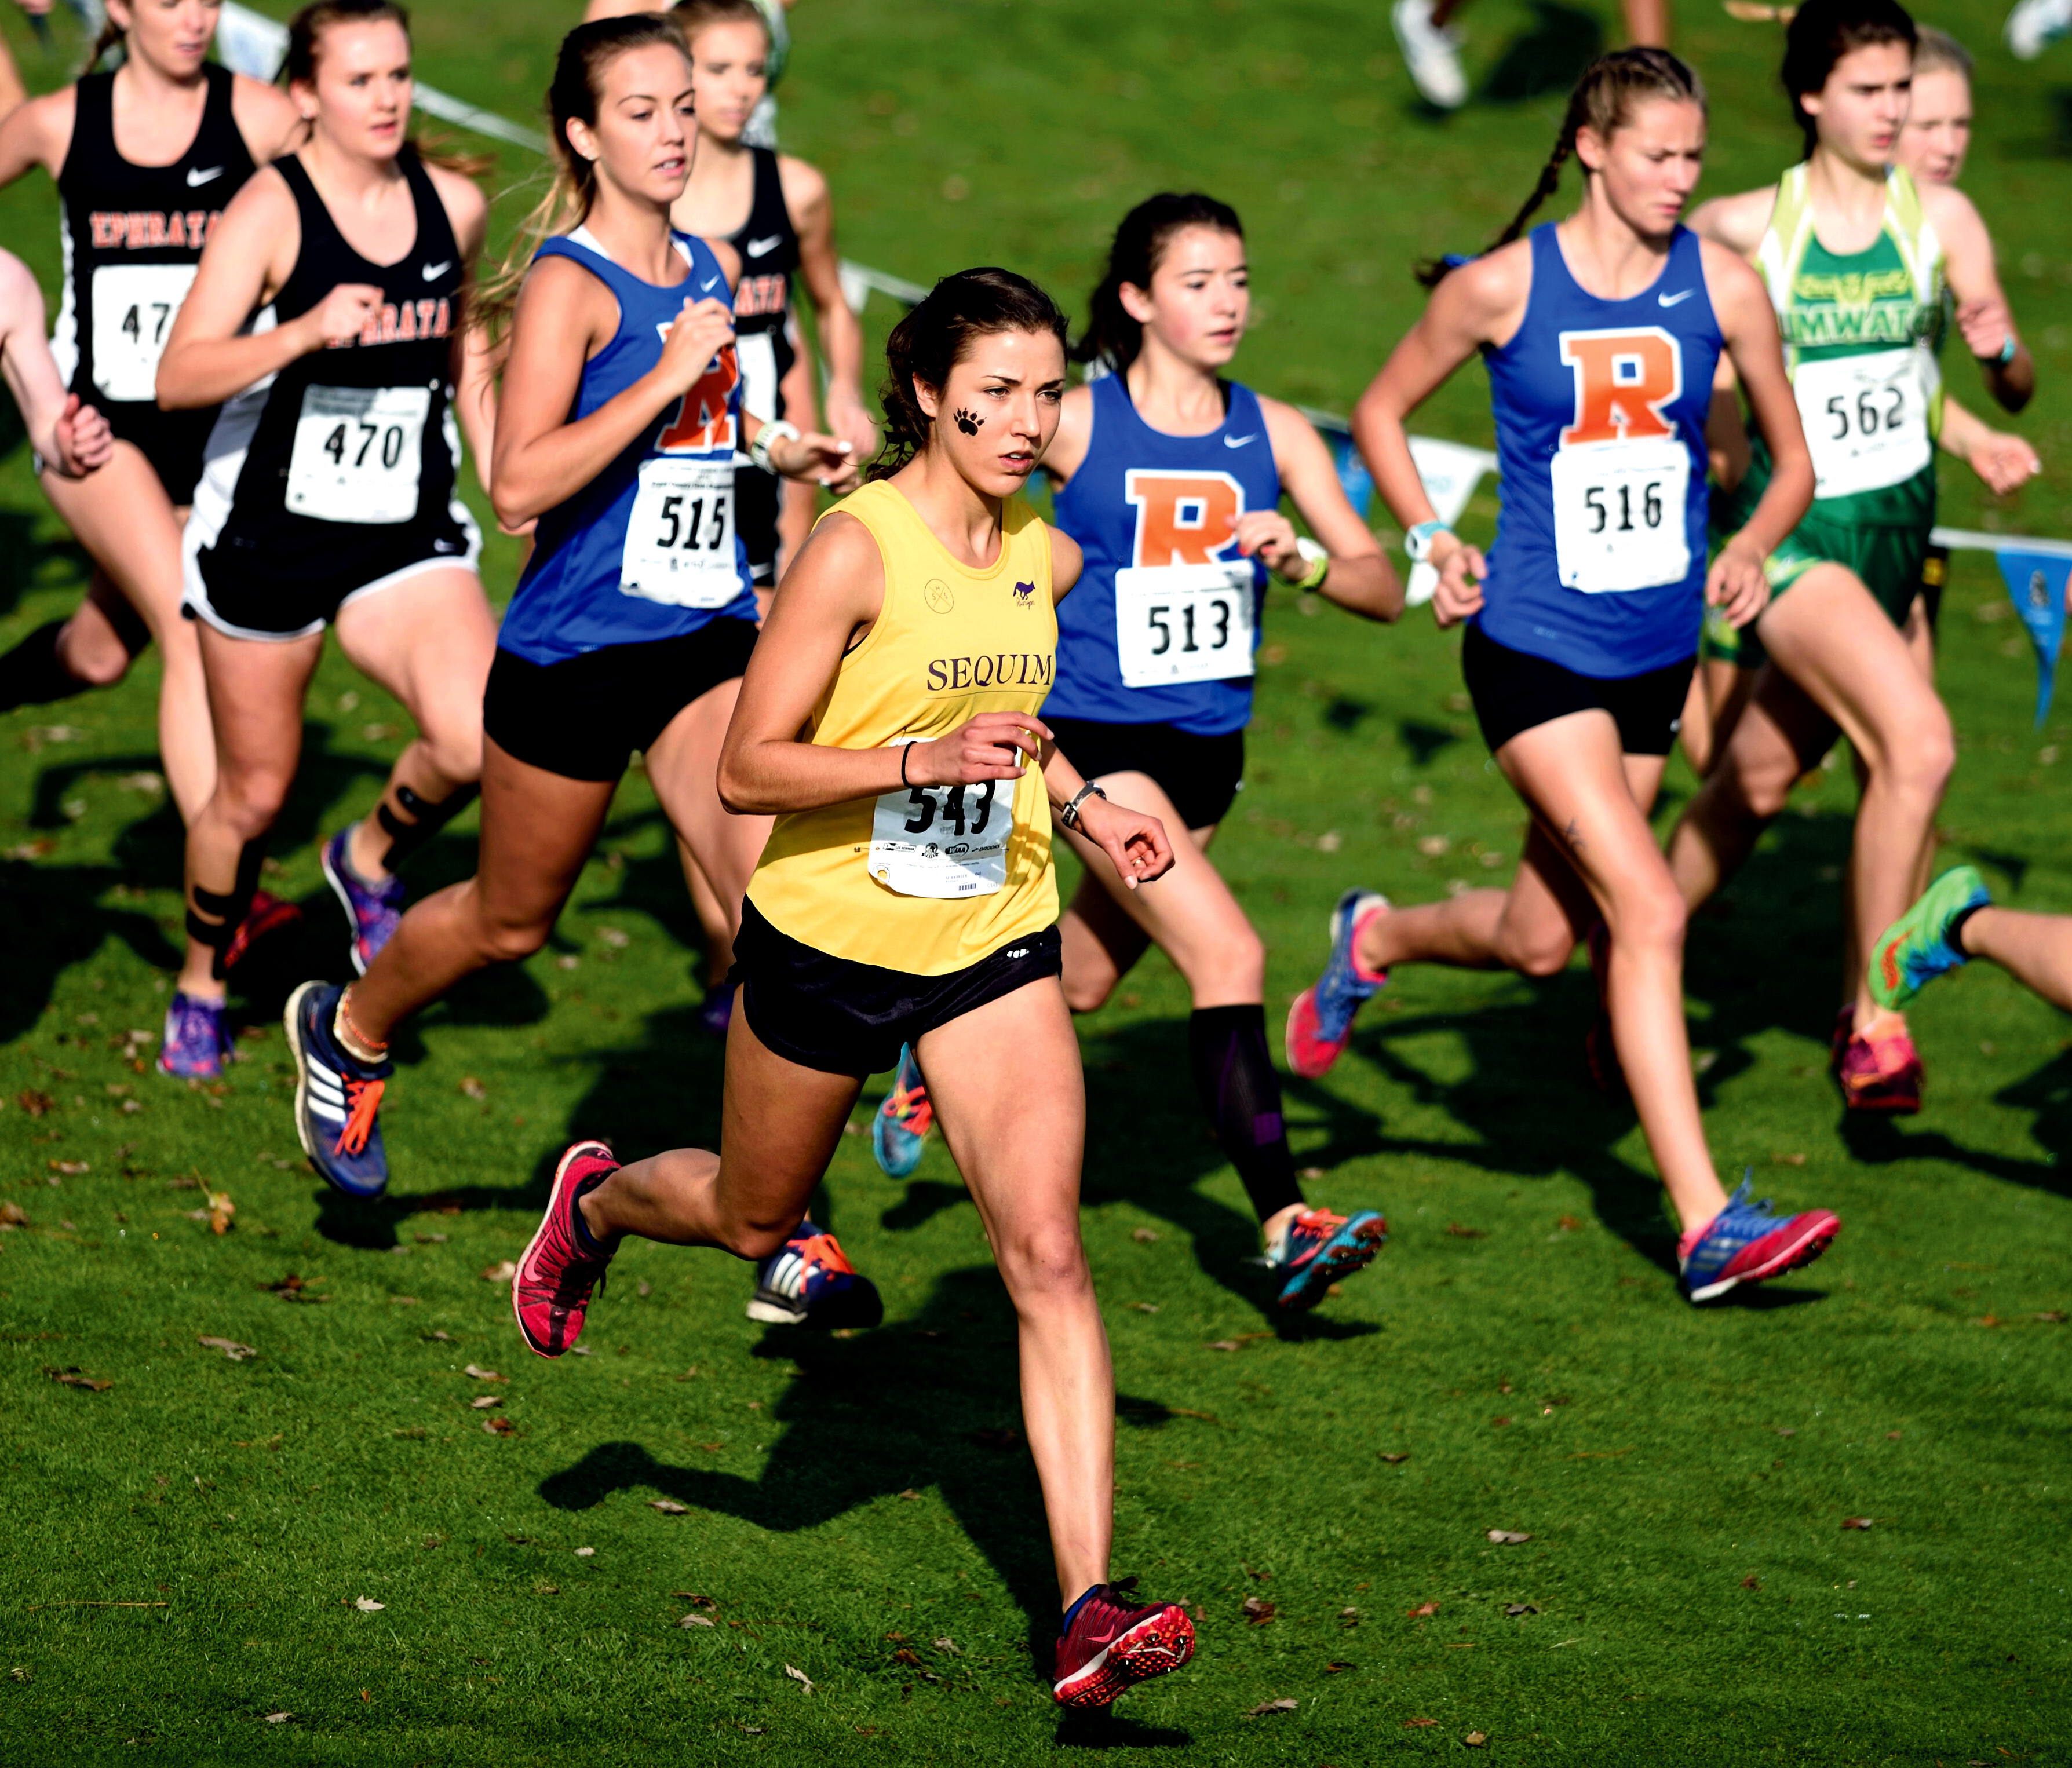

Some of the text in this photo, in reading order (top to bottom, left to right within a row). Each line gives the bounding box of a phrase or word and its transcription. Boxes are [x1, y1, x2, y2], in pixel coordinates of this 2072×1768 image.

[122, 302, 171, 344] 47
[1559, 325, 1683, 446] R
[1826, 387, 1904, 440] 562
[324, 423, 403, 469] 470
[656, 496, 725, 550] 515
[1125, 468, 1245, 568] R
[1585, 481, 1662, 533] 516
[1148, 600, 1230, 655] 513
[926, 654, 1052, 691] SEQUIM
[904, 780, 996, 836] 543
